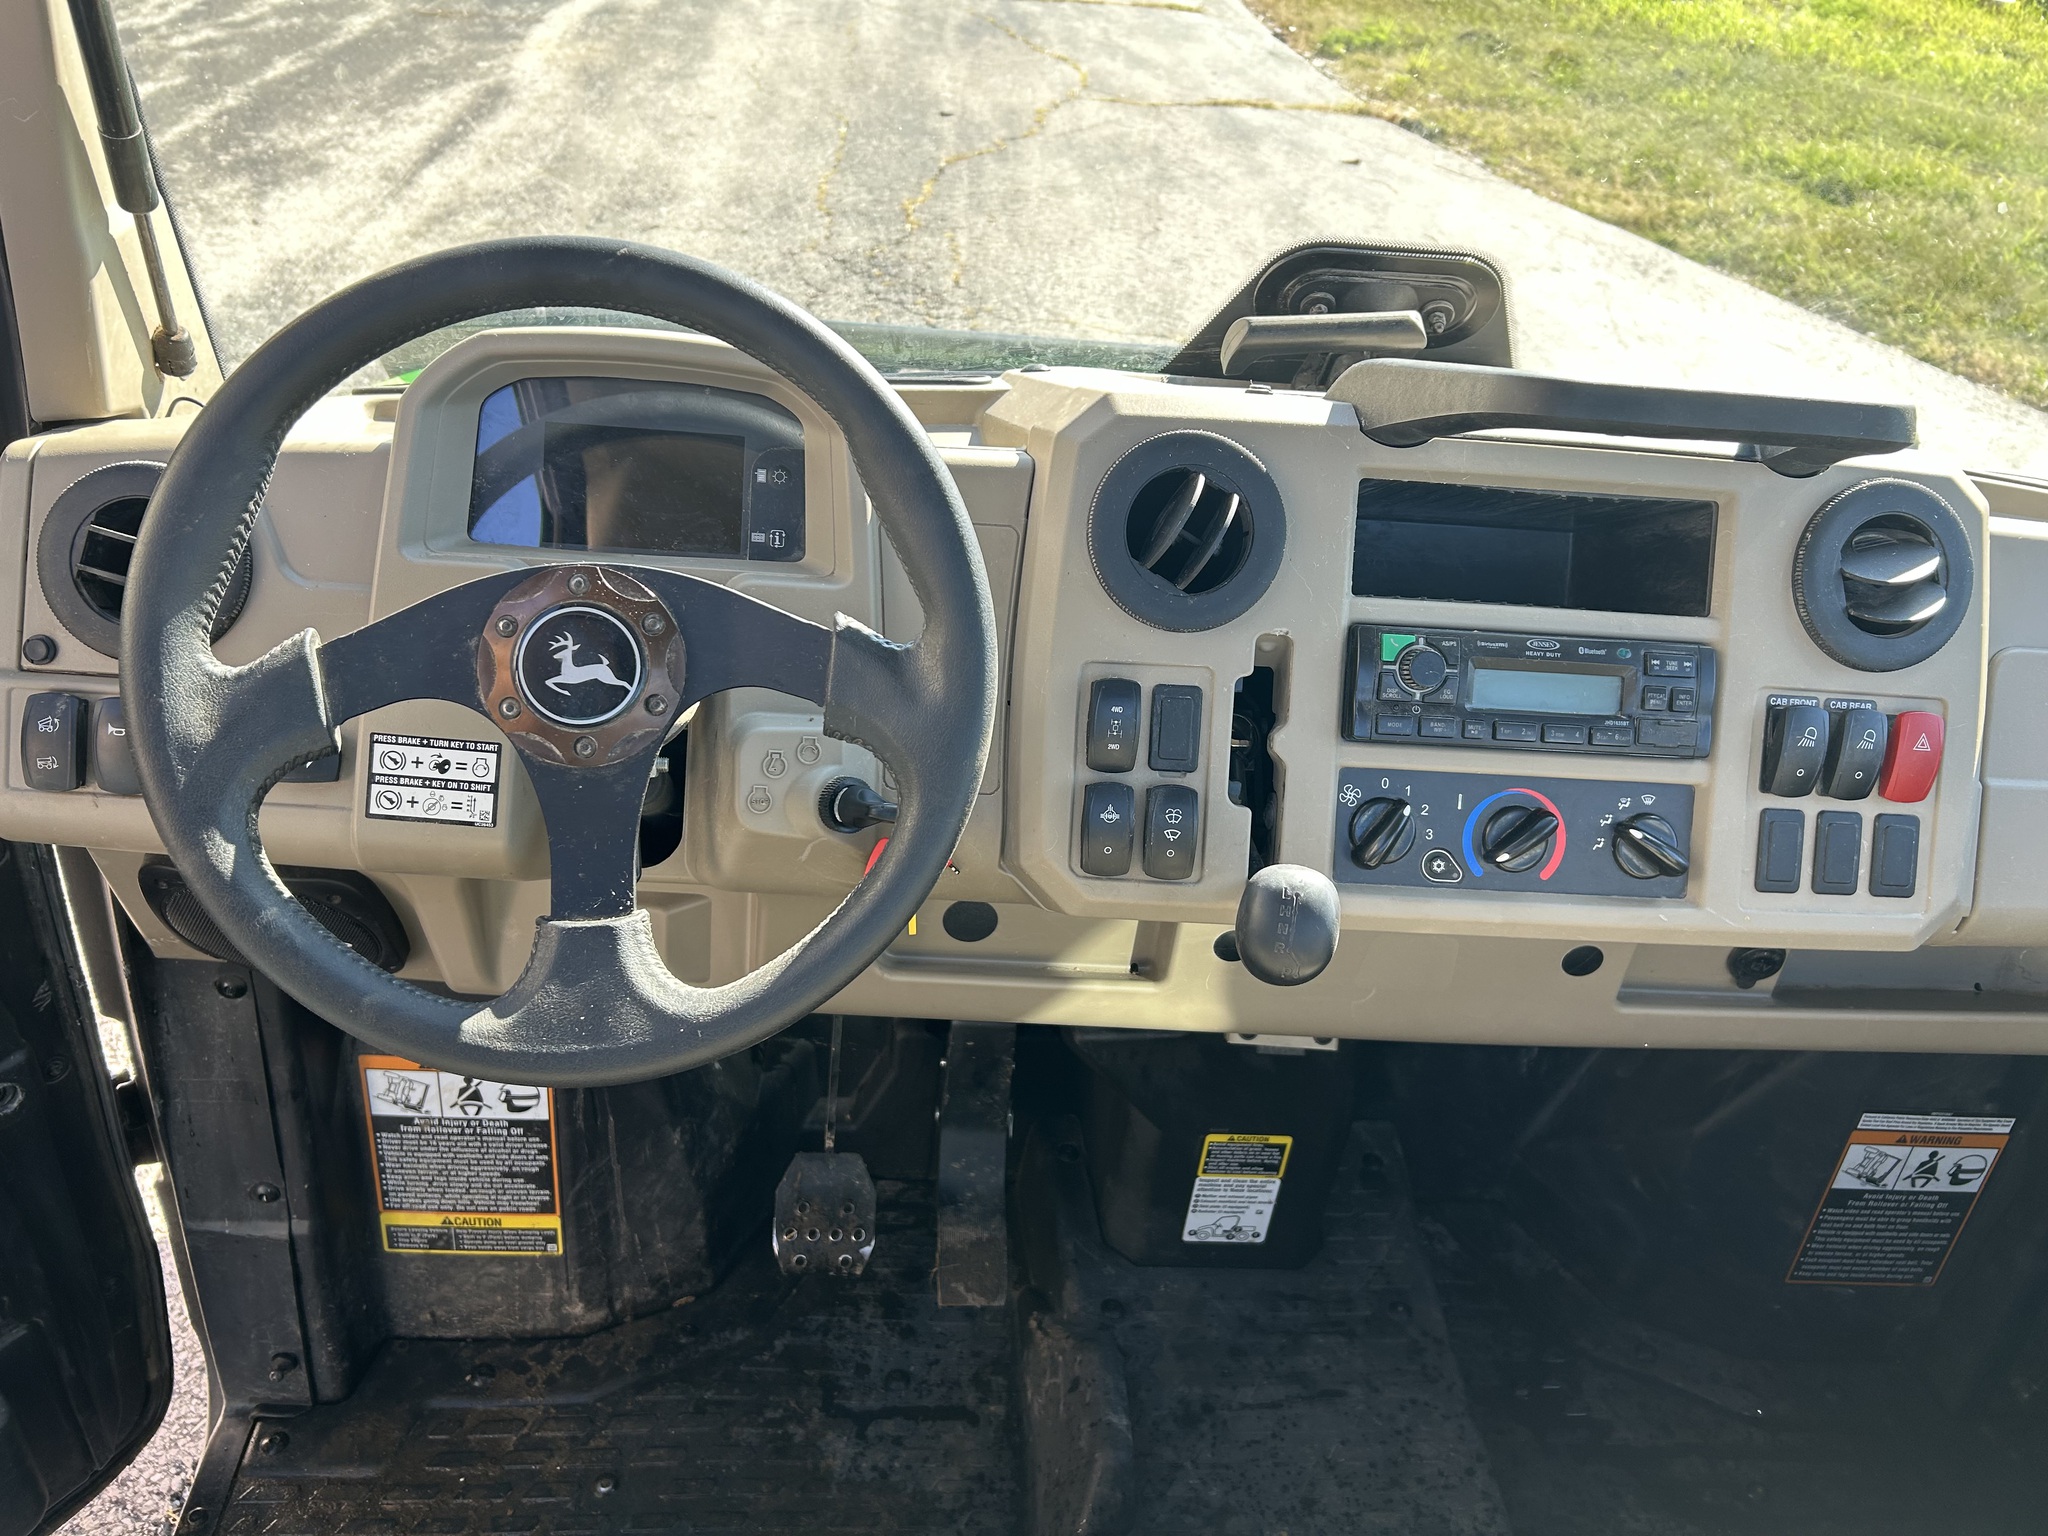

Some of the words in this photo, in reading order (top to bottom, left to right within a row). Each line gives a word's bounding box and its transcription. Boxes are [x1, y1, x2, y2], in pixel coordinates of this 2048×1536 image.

[1770, 697, 1788, 706] CAB
[1789, 699, 1818, 707] FRONT
[1830, 701, 1847, 710] CAB
[1849, 702, 1872, 711] REAR
[373, 734, 396, 744] PRESS
[398, 736, 421, 746] BRAKE
[430, 739, 449, 748] TURN
[450, 741, 465, 749] KEY
[466, 742, 475, 750] TO
[476, 743, 499, 752] START
[1107, 743, 1120, 751] 2WD
[375, 775, 398, 785] PRESS
[400, 777, 423, 787] BRAKE
[431, 780, 446, 789] KEY
[447, 781, 458, 789] ON
[459, 782, 469, 790] TO
[470, 783, 492, 792] SHIFT
[1381, 777, 1389, 789] 0
[1405, 785, 1411, 797] 1
[1420, 804, 1429, 816] 2
[1425, 828, 1434, 841] 3
[1282, 886, 1292, 899] L
[1279, 905, 1291, 917] H
[1277, 922, 1290, 935] N
[1274, 943, 1286, 954] R
[414, 1117, 439, 1125] Avoid
[442, 1118, 468, 1127] Injury
[470, 1119, 479, 1127] or
[483, 1120, 509, 1128] Death
[424, 1125, 462, 1134] Rollover
[464, 1127, 474, 1135] or
[476, 1127, 508, 1137] Falling
[510, 1128, 524, 1136] Off
[1909, 1135, 1963, 1146] WARNING
[1885, 1193, 1906, 1201] Injury
[1910, 1201, 1935, 1209] Falling
[454, 1216, 502, 1226] CAUTION
